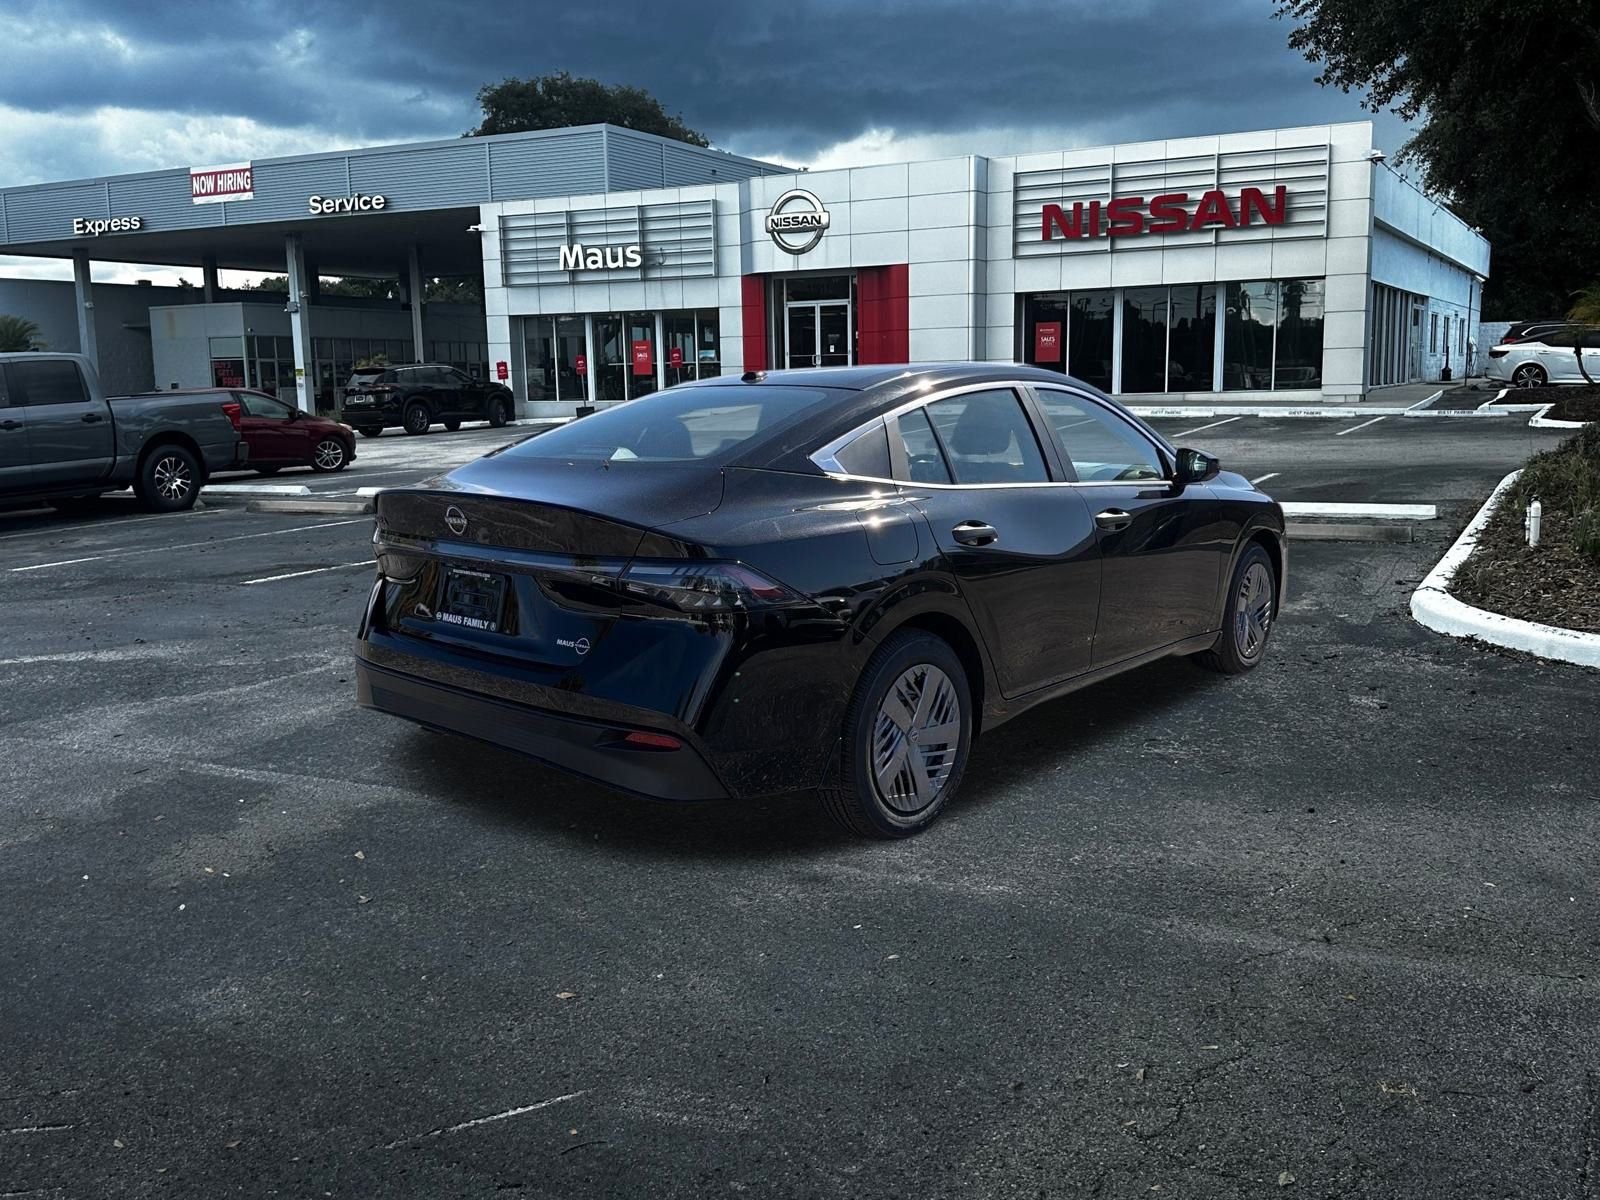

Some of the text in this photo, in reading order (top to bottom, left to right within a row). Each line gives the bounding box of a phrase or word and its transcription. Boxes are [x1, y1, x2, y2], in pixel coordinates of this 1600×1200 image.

[192, 171, 251, 195] NOW HIRING
[309, 193, 385, 214] Service
[1042, 185, 1287, 241] NISSAN
[73, 216, 141, 236] Express
[770, 214, 822, 228] NISSAN
[559, 243, 642, 271] Maus
[442, 612, 489, 629] MAUS FAMILY
[556, 638, 575, 648] MAUS
